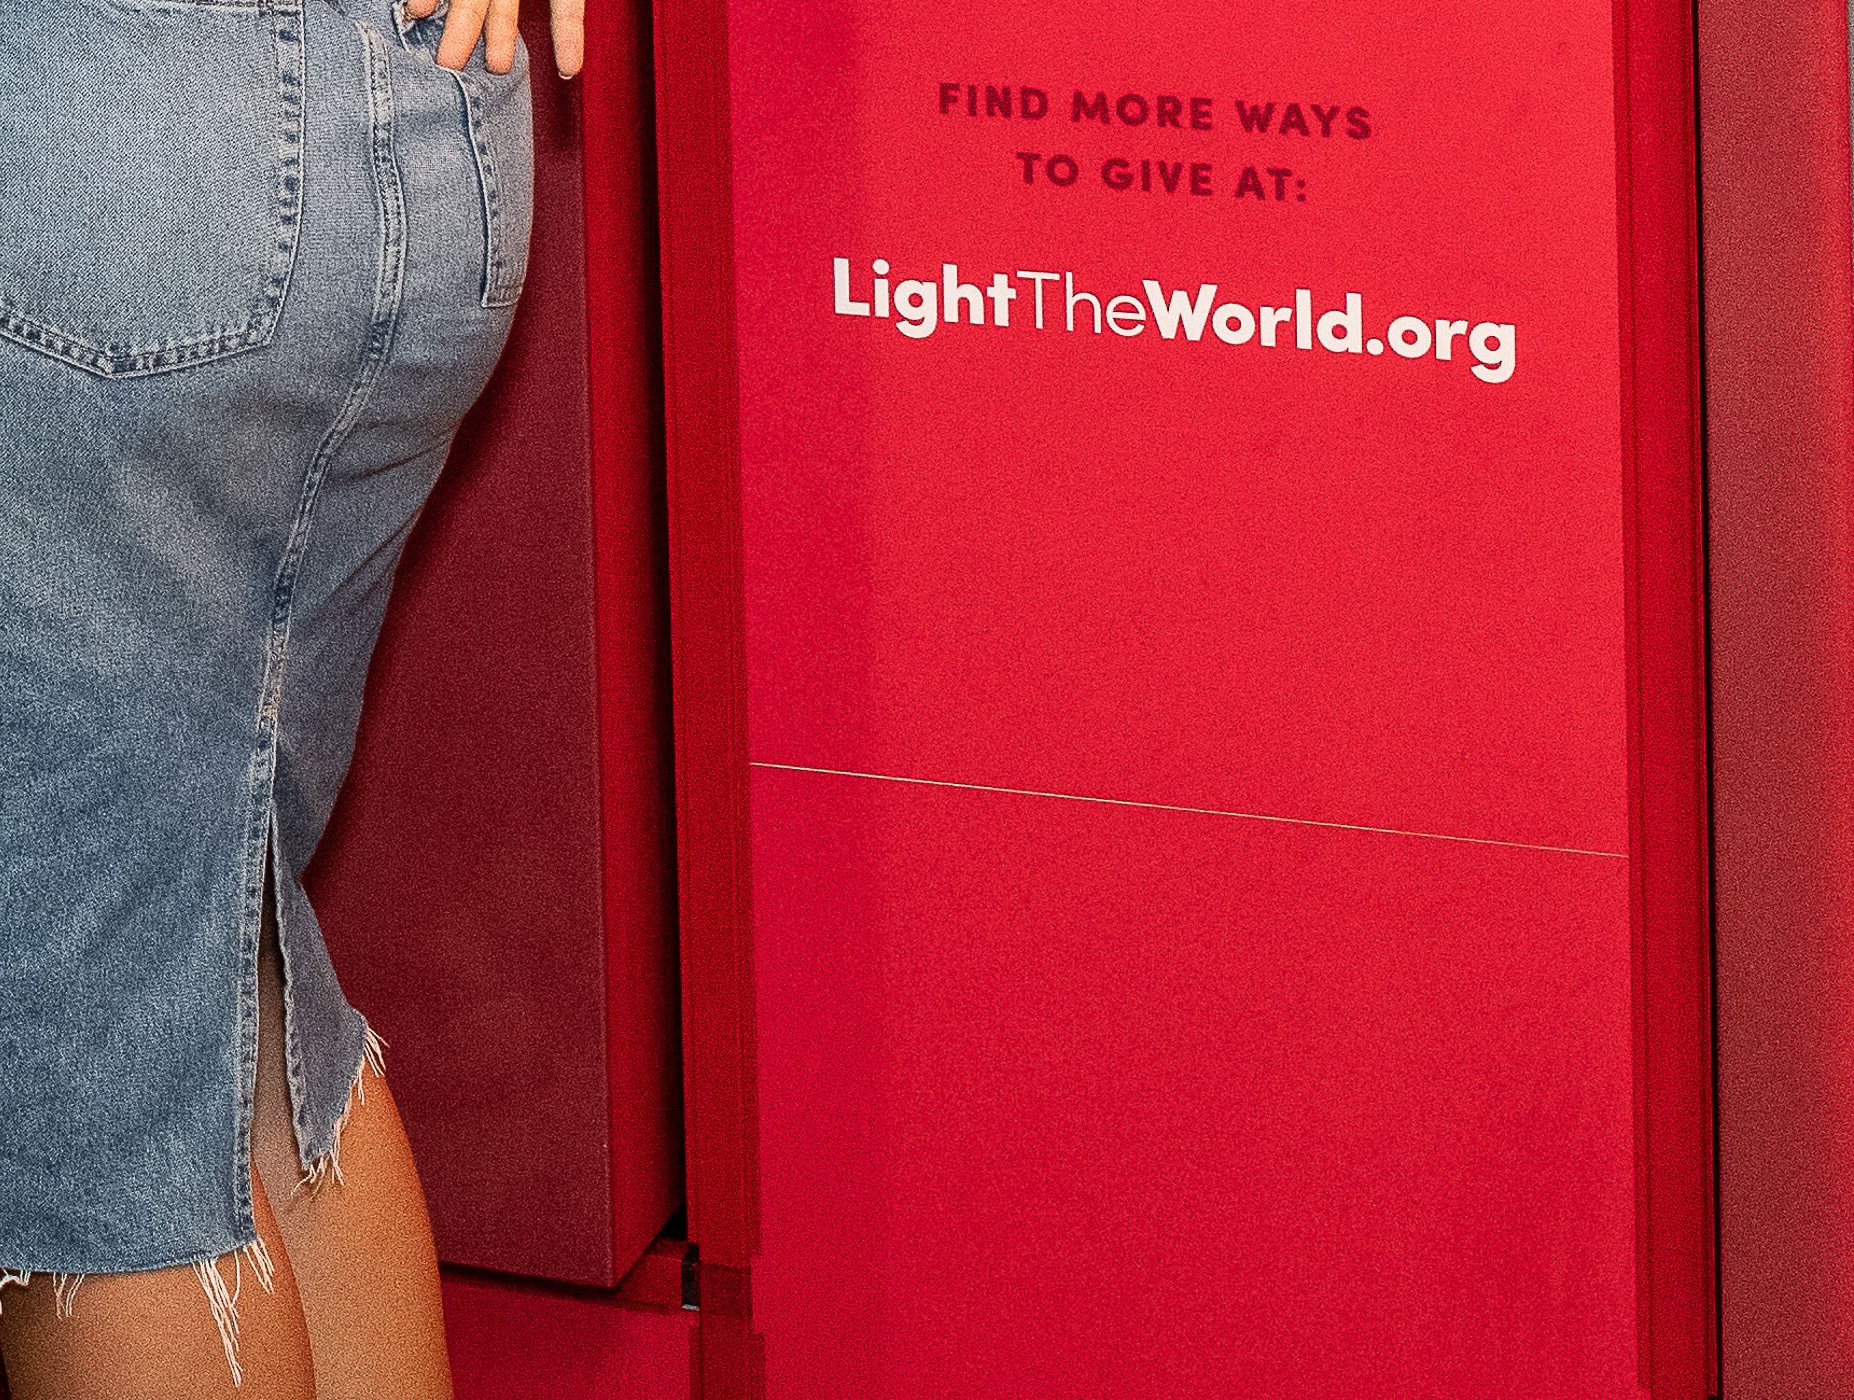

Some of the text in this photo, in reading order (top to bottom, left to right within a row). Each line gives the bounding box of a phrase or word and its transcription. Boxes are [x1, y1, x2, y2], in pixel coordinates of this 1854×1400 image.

[938, 81, 1373, 141] FIND MORE WAYS
[1016, 151, 1308, 202] TO GIVE AT:
[832, 257, 1518, 385] LightTheWorld.org
